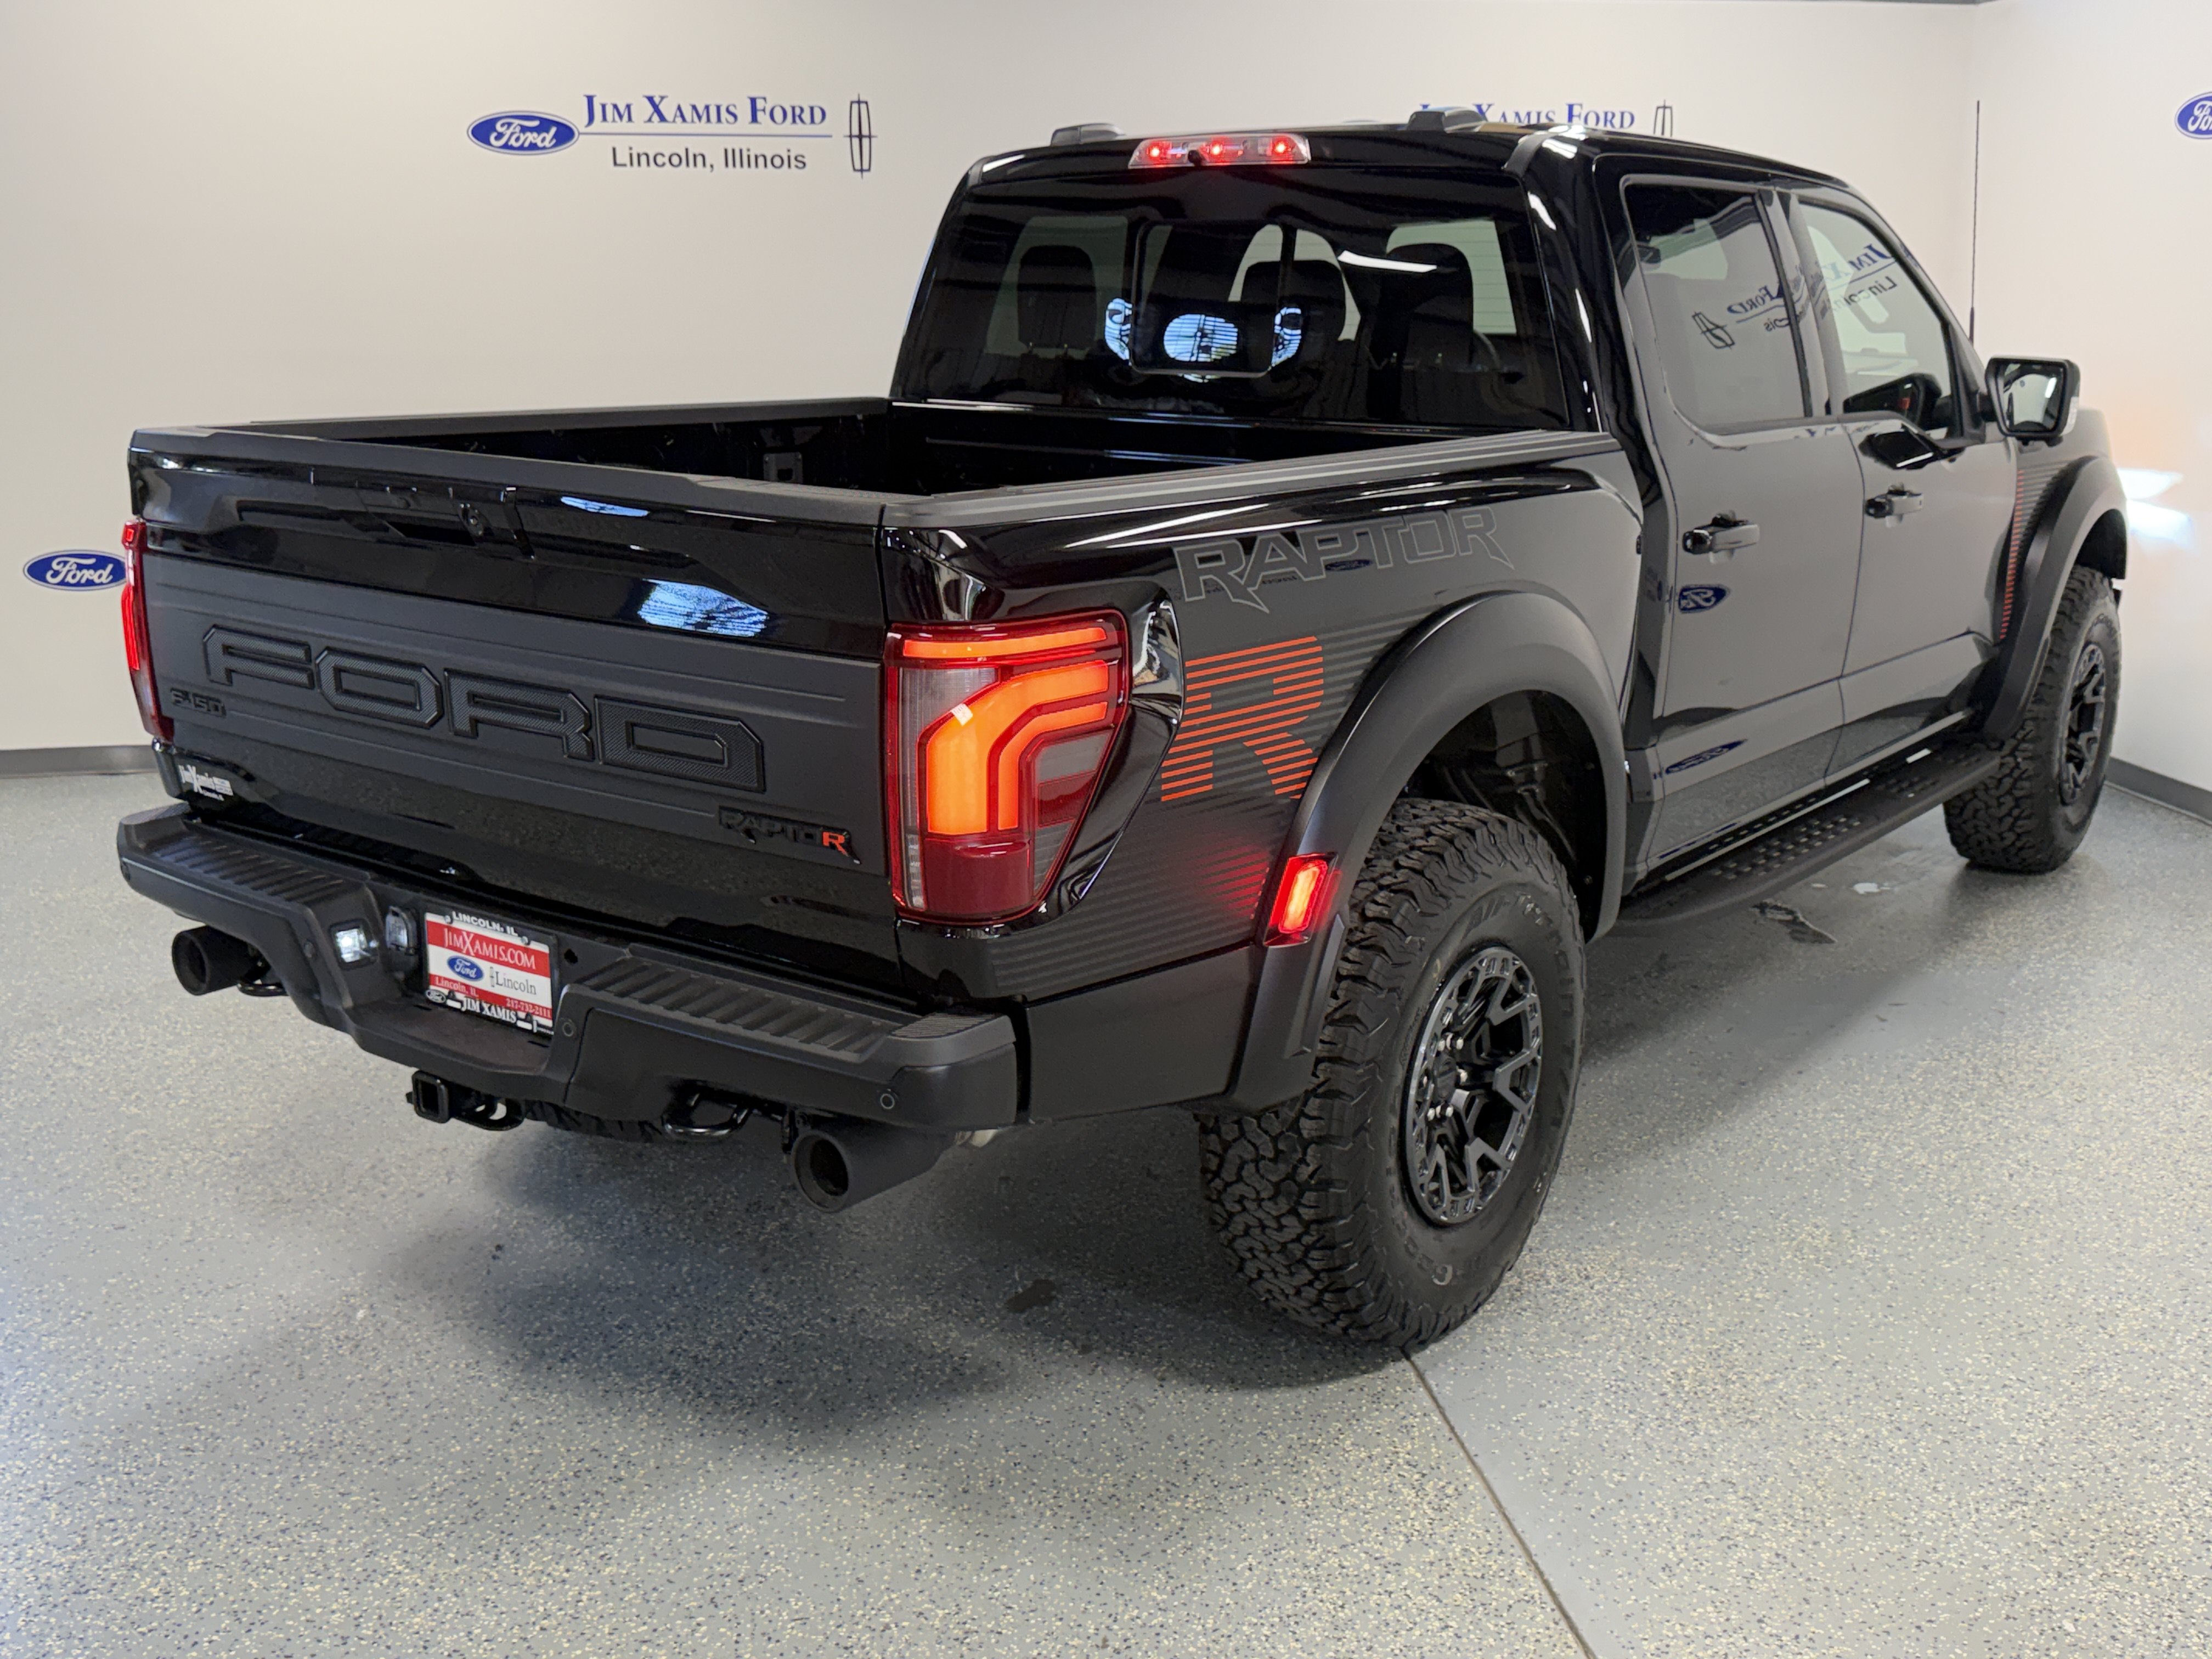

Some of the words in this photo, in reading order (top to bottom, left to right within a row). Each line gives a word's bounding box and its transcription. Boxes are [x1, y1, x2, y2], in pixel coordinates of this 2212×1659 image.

[583, 94, 634, 128] JIM
[643, 95, 738, 125] XAMIS
[747, 96, 826, 126] FORD
[2188, 100, 2212, 132] Fo
[489, 118, 556, 148] Ford
[612, 146, 715, 172] Lincoln,
[724, 148, 806, 170] Illinois
[46, 557, 114, 584] Ford
[1173, 507, 1515, 613] RAPTOR
[202, 624, 766, 794] FORD
[506, 925, 518, 936] IL
[454, 958, 477, 979] Ford
[495, 971, 537, 995] Lincoln
[461, 997, 481, 1013] JIM
[481, 1000, 517, 1024] XAMIS
